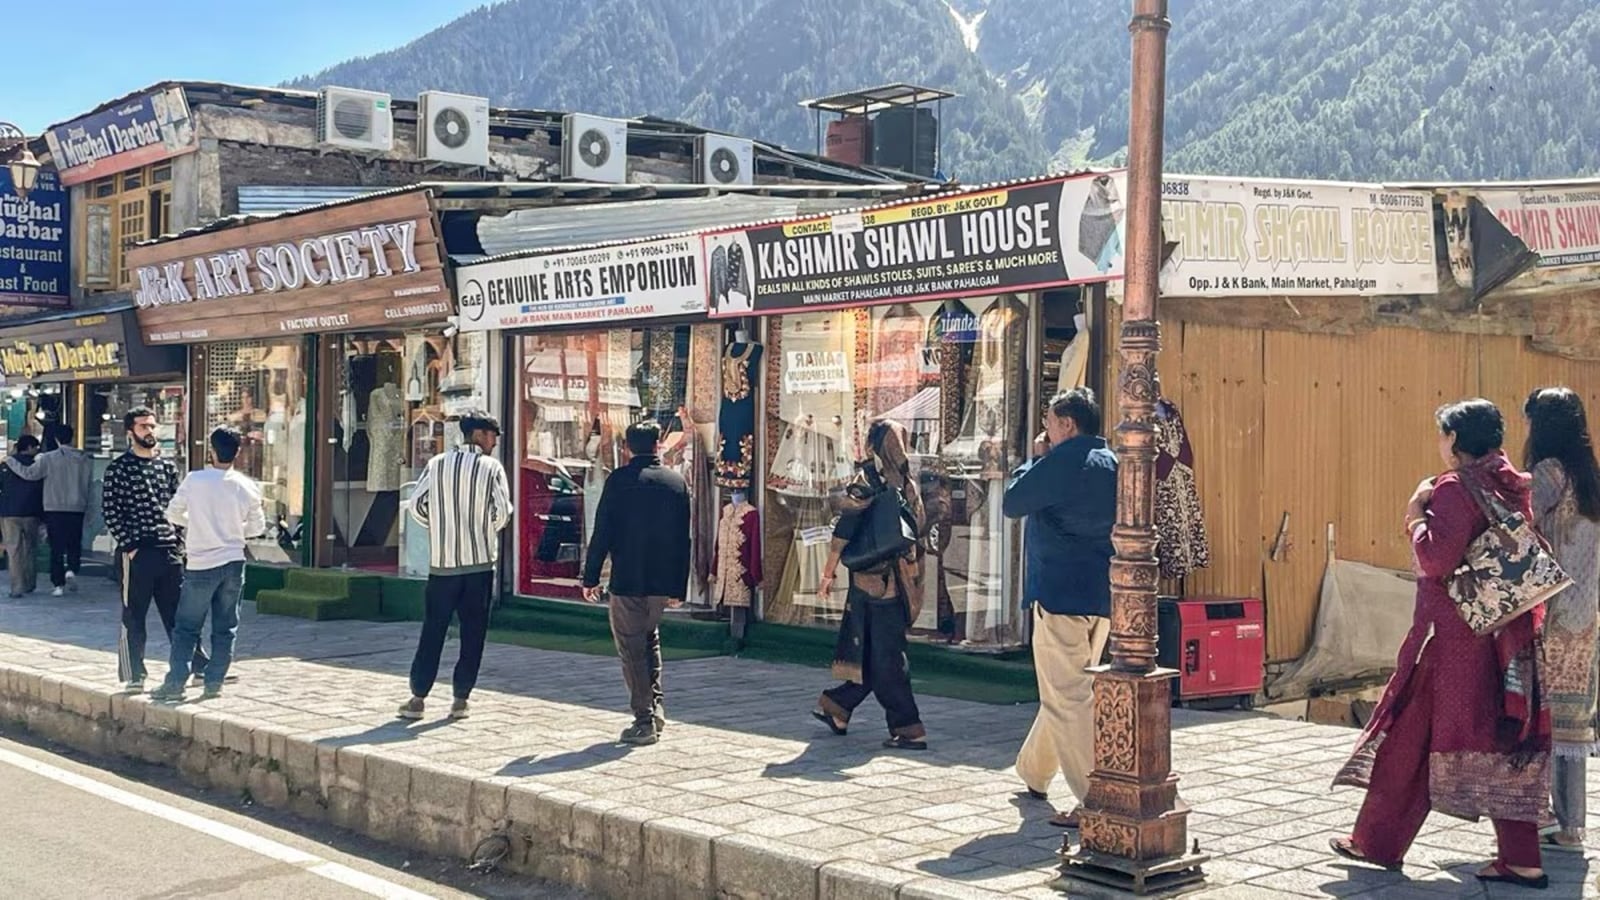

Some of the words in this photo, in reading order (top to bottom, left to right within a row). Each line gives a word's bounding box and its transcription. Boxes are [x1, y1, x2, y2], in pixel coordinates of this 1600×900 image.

[61, 128, 113, 167] Mughal
[108, 118, 160, 154] Darbar
[1274, 189, 1281, 200] by
[1296, 191, 1313, 200] Govt.
[1380, 194, 1424, 206] 6006777563
[0, 199, 61, 223] ughal
[911, 208, 936, 218] REGD.
[936, 203, 952, 214] BY:
[954, 200, 973, 212] J&K
[973, 195, 998, 208] GOVT
[792, 222, 830, 235] CONTACT:
[1161, 199, 1250, 273] HMIR
[1254, 203, 1348, 272] SHAWL
[1351, 207, 1432, 273] HOUSE
[1555, 205, 1600, 249] SHAW
[757, 233, 859, 280] KASHMIR
[864, 218, 955, 270] SHAWL
[960, 202, 1051, 257] HOUSE
[0, 245, 63, 263] staurant
[135, 260, 193, 310] J&K
[193, 248, 254, 301] ART
[256, 220, 420, 292] SOCIETY
[0, 276, 18, 291] ast
[23, 276, 58, 293] Food
[487, 273, 549, 307] GENUINE
[554, 267, 593, 301] ARTS
[599, 255, 697, 296] EMPORIUM
[757, 282, 781, 295] DEALS
[781, 281, 790, 292] IN
[791, 279, 806, 292] ALL
[806, 277, 830, 290] KINDS
[831, 276, 843, 287] OF
[844, 273, 880, 286] SHAWLS
[881, 269, 915, 284] STOLES,
[917, 265, 945, 280] SUITS,
[946, 260, 983, 276] SAREE'S
[985, 259, 994, 271] &
[995, 255, 1026, 270] MUCH
[1027, 251, 1059, 266] MORE
[1189, 276, 1212, 292] Opp.
[1221, 277, 1230, 289] &
[1232, 277, 1240, 289] K
[1241, 277, 1268, 291] Bank,
[1271, 277, 1295, 289] Main
[1297, 278, 1332, 291] Market,
[1333, 278, 1376, 292] Pahalgam
[461, 293, 483, 308] GAE
[803, 294, 823, 305] MAIN
[822, 292, 850, 303] MARKET
[851, 286, 894, 300] PAHALGAM,
[894, 284, 914, 296] NEAR
[915, 282, 931, 293] J&K
[931, 280, 953, 292] BANK
[954, 275, 1000, 290] PAHALGAM
[320, 313, 349, 327] OUTLET
[530, 313, 551, 323] BANK
[552, 311, 573, 321] MAIN
[574, 309, 606, 319] MARKET
[608, 305, 654, 317] PAHALGAM
[54, 338, 119, 370] Darbar
